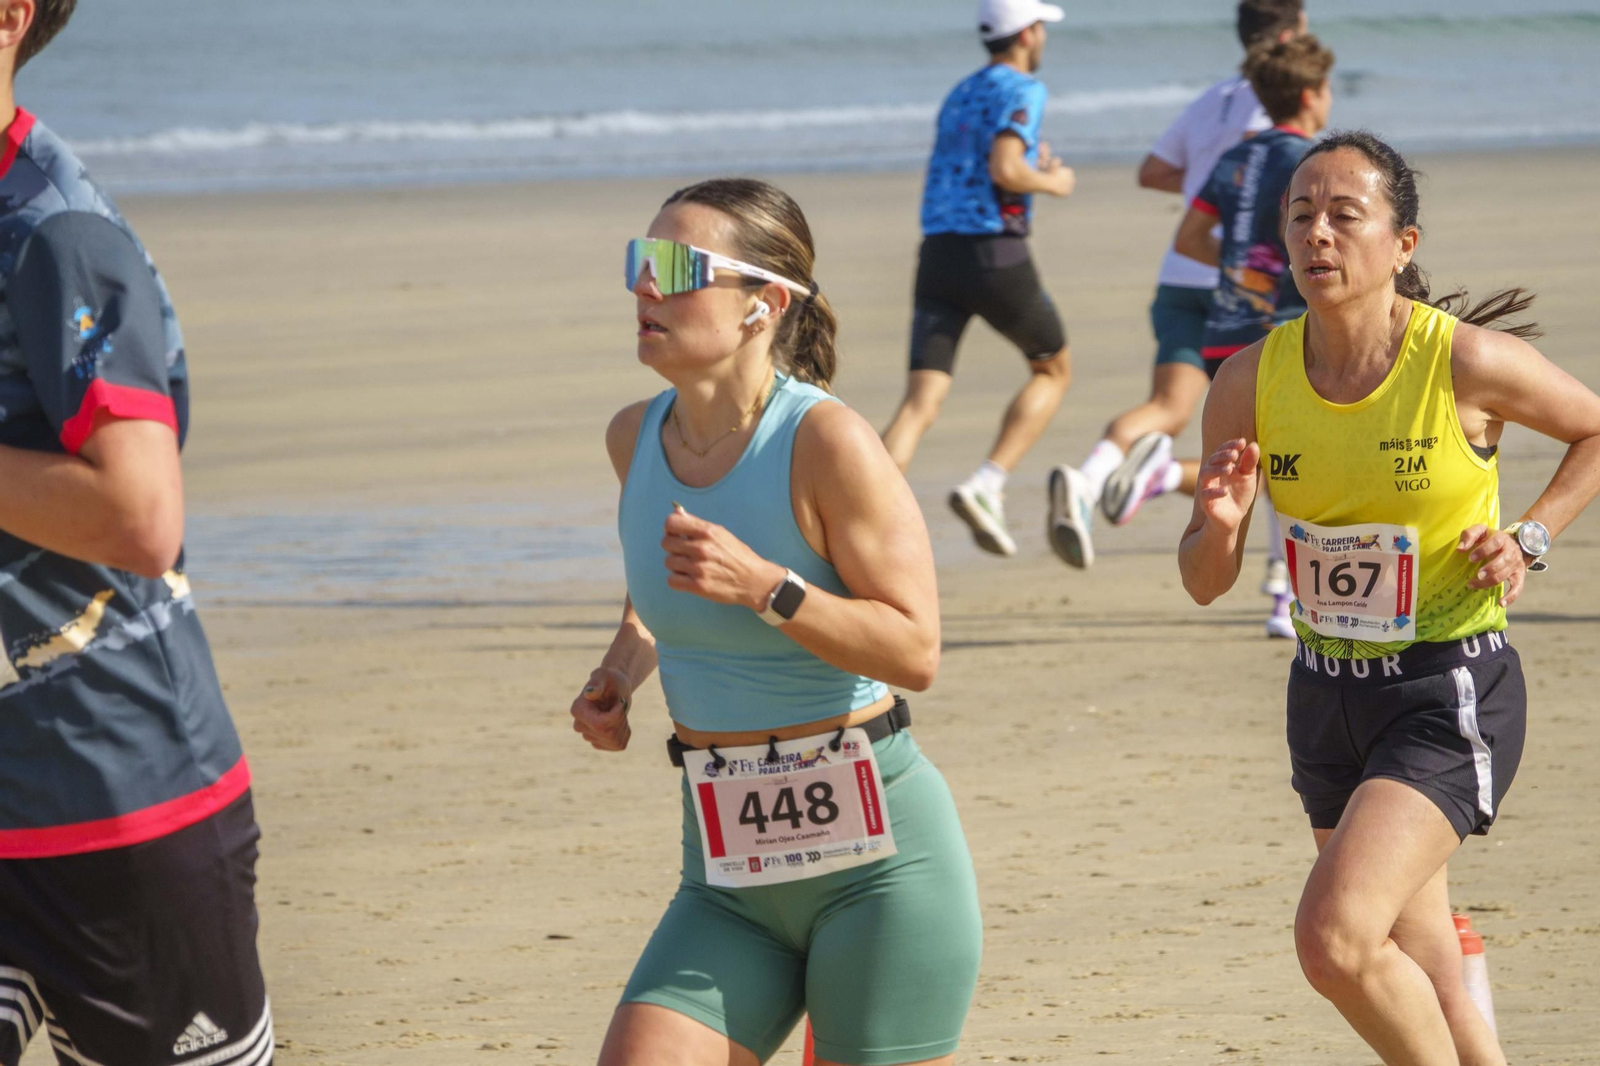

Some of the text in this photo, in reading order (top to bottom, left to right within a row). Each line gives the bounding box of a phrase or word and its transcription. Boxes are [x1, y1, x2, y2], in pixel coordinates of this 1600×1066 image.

[1269, 453, 1302, 476] DK
[1394, 477, 1430, 492] VIGO
[1322, 536, 1360, 546] CARREIRA
[1310, 560, 1382, 598] 167
[1336, 616, 1349, 624] 100
[1462, 628, 1508, 658] UN
[758, 766, 780, 775] PRAIA
[782, 764, 791, 772] DE
[738, 781, 840, 834] 448
[755, 830, 831, 846] Mirian Ojea Caamaño
[785, 853, 803, 864] 100
[173, 1028, 228, 1056] adidas
